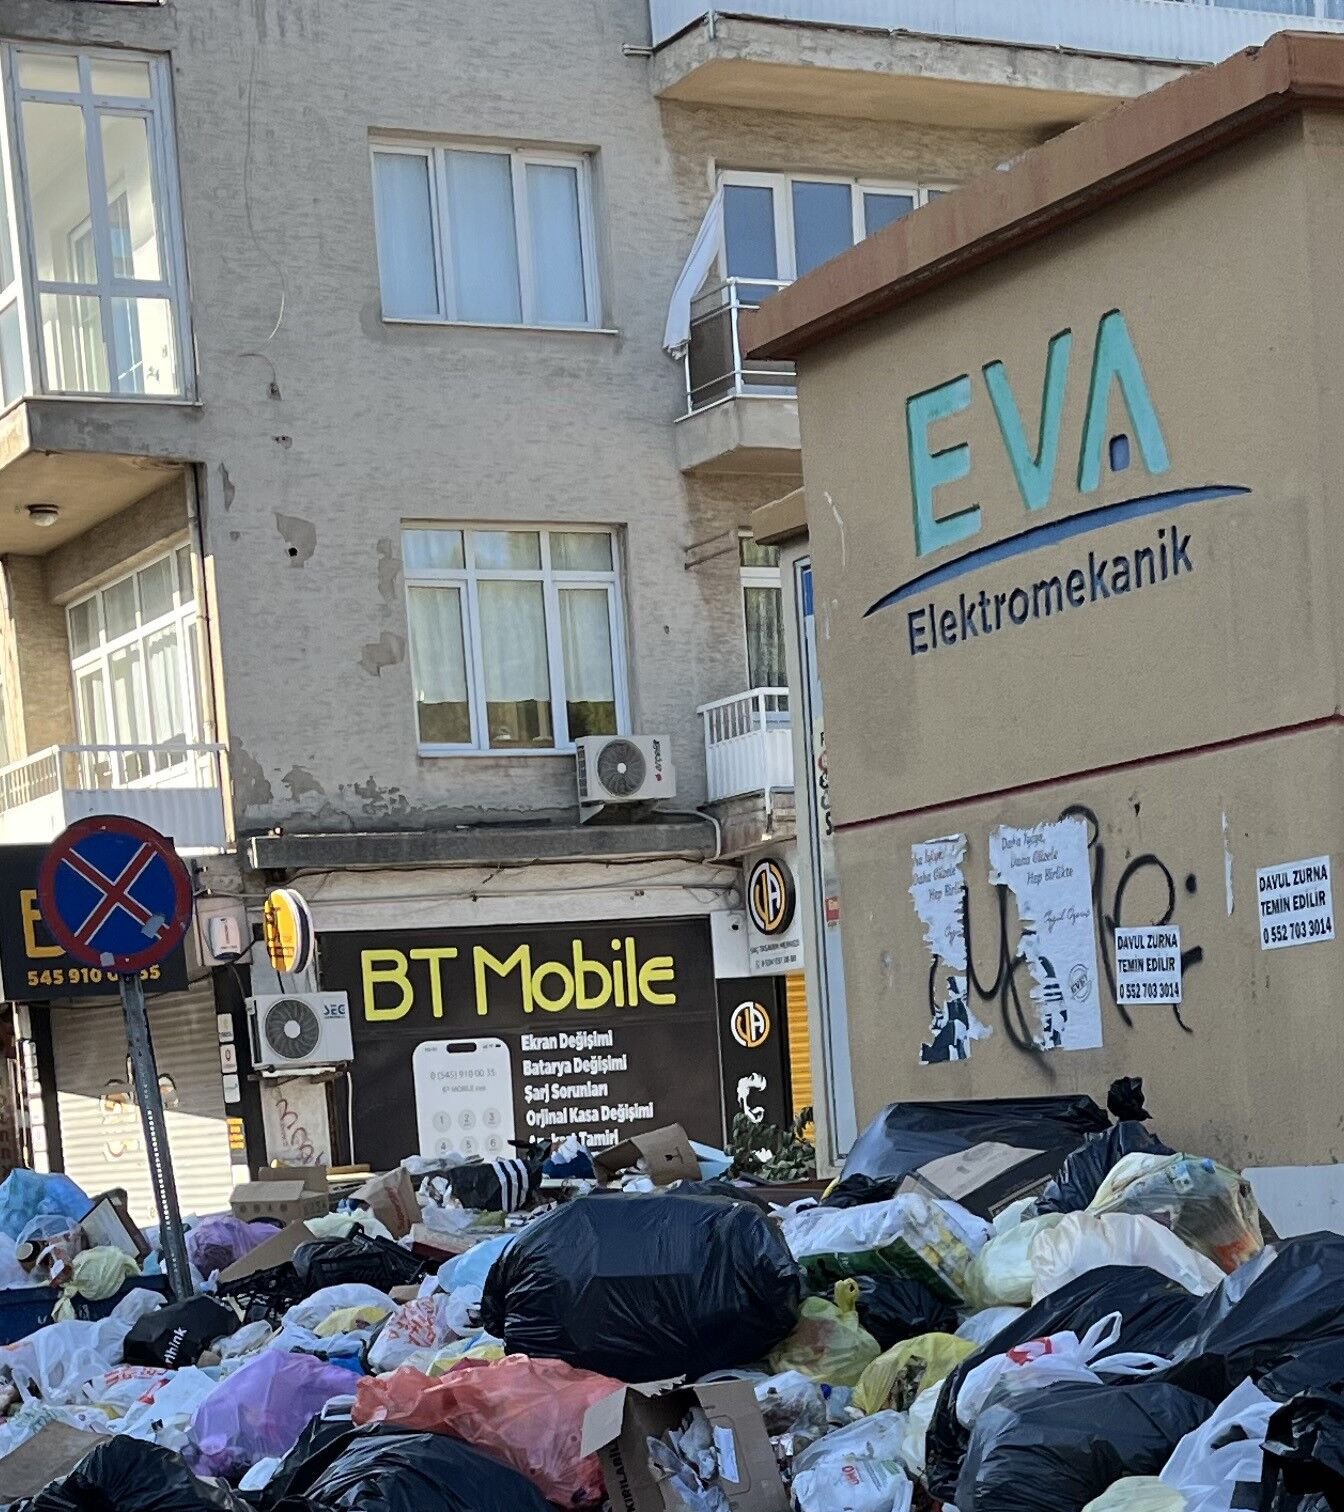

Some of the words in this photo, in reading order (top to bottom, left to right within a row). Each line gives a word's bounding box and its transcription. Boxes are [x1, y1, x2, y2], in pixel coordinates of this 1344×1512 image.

[906, 308, 1172, 557] EVA
[908, 524, 1195, 656] Elektromekanik
[1259, 872, 1291, 893] DAVUL
[1292, 864, 1328, 886] ZURNA
[1117, 935, 1145, 950] DAVUL
[1147, 933, 1178, 949] ZURNA
[1263, 928, 1269, 944] 0
[1271, 924, 1288, 943] 552
[1290, 921, 1307, 939] 703
[1308, 916, 1332, 937] 3014
[27, 969, 64, 986] 545
[68, 968, 103, 984] 910
[362, 947, 458, 1022] BT
[474, 936, 677, 1016] Mobile
[1119, 985, 1125, 999] 0
[1126, 984, 1141, 999] 552
[1142, 983, 1157, 998] 703
[1159, 982, 1179, 998] 3014
[520, 1033, 557, 1051] Ekran
[559, 1029, 614, 1050] Değişimi
[522, 1059, 572, 1077] Batarya
[573, 1054, 627, 1075] Değişimi
[524, 1085, 550, 1104] Şarj
[551, 1081, 608, 1099] Sorunları
[526, 1107, 567, 1128] Orjinal
[569, 1106, 599, 1122] Kasa
[601, 1102, 654, 1123] Değişimi
[578, 1129, 619, 1148] Tamiri
